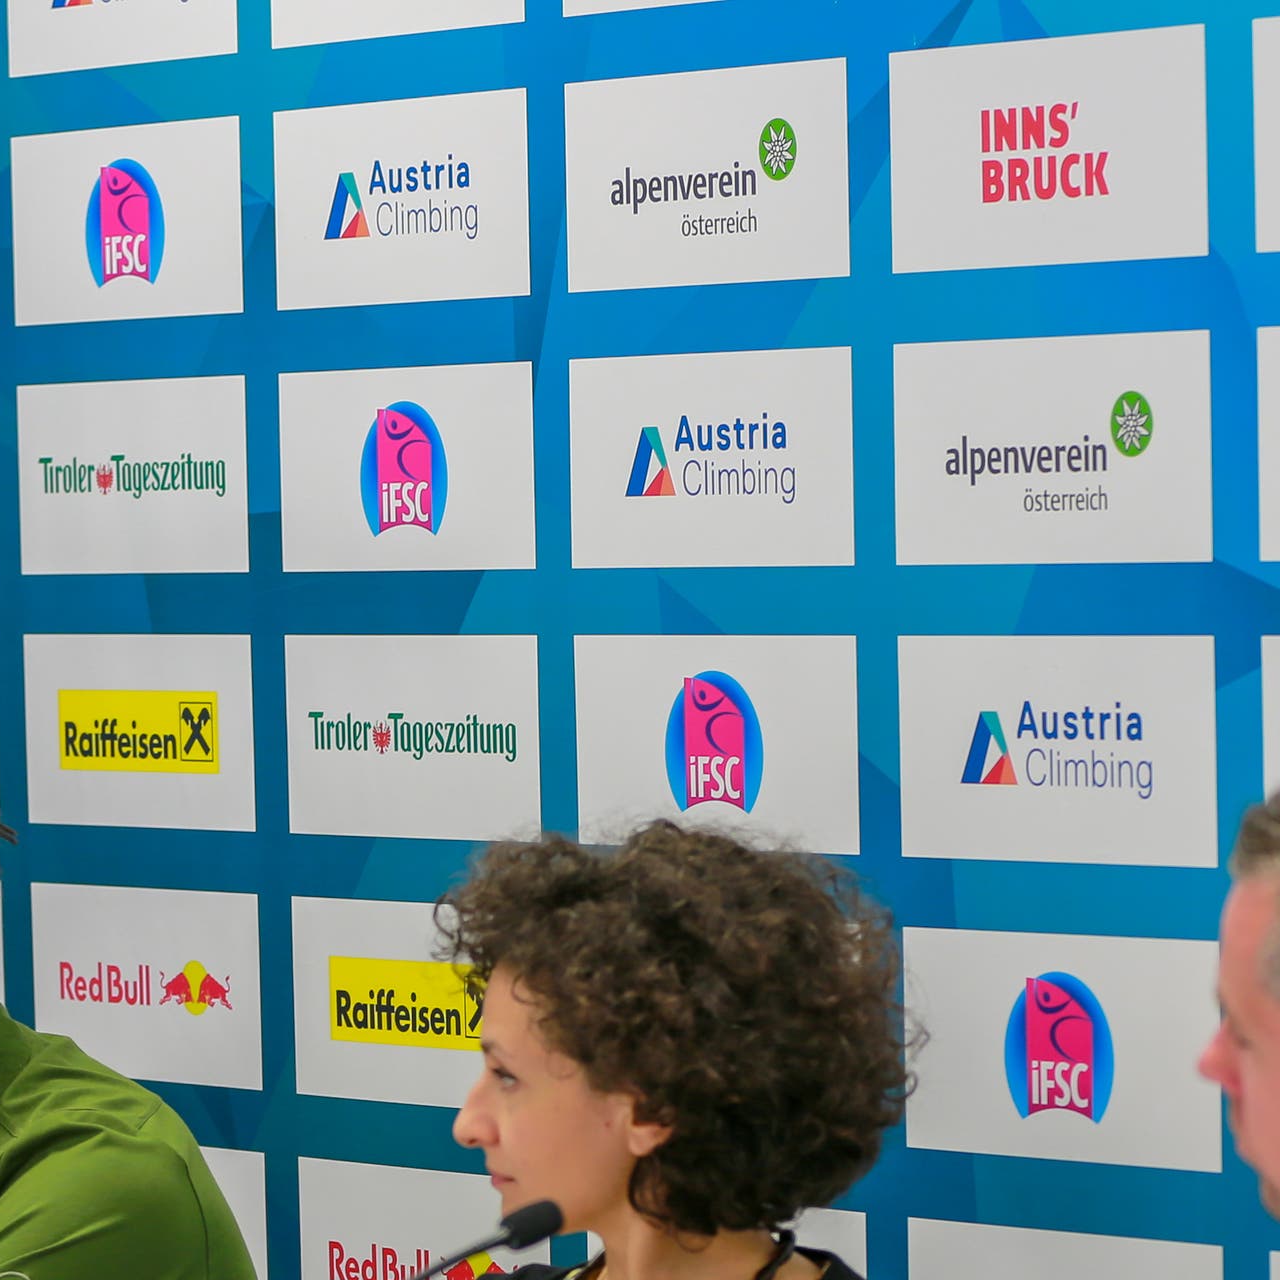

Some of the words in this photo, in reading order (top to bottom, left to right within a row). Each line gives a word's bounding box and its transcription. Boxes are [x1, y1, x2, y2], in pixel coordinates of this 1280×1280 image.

[369, 154, 470, 195] Austria
[610, 162, 756, 213] alpenverein
[982, 152, 1109, 203] BRUCK
[376, 199, 478, 240] Climbing
[681, 210, 757, 237] österreich
[675, 413, 786, 452] Austria
[38, 456, 95, 495] Tiroler
[111, 453, 226, 499] Tageszeitung
[682, 460, 796, 503] Climbing
[945, 436, 1108, 485] alpenverein
[1023, 487, 1108, 513] österreich
[65, 719, 177, 760] Raiffeisen
[309, 711, 371, 752] Tiroler
[387, 712, 517, 762] Tageszeitung
[1017, 701, 1143, 741] Austria
[1026, 748, 1153, 799] Climbing
[60, 962, 102, 1002] Red
[107, 965, 150, 1006] Bull
[336, 987, 461, 1036] Raiffeisen
